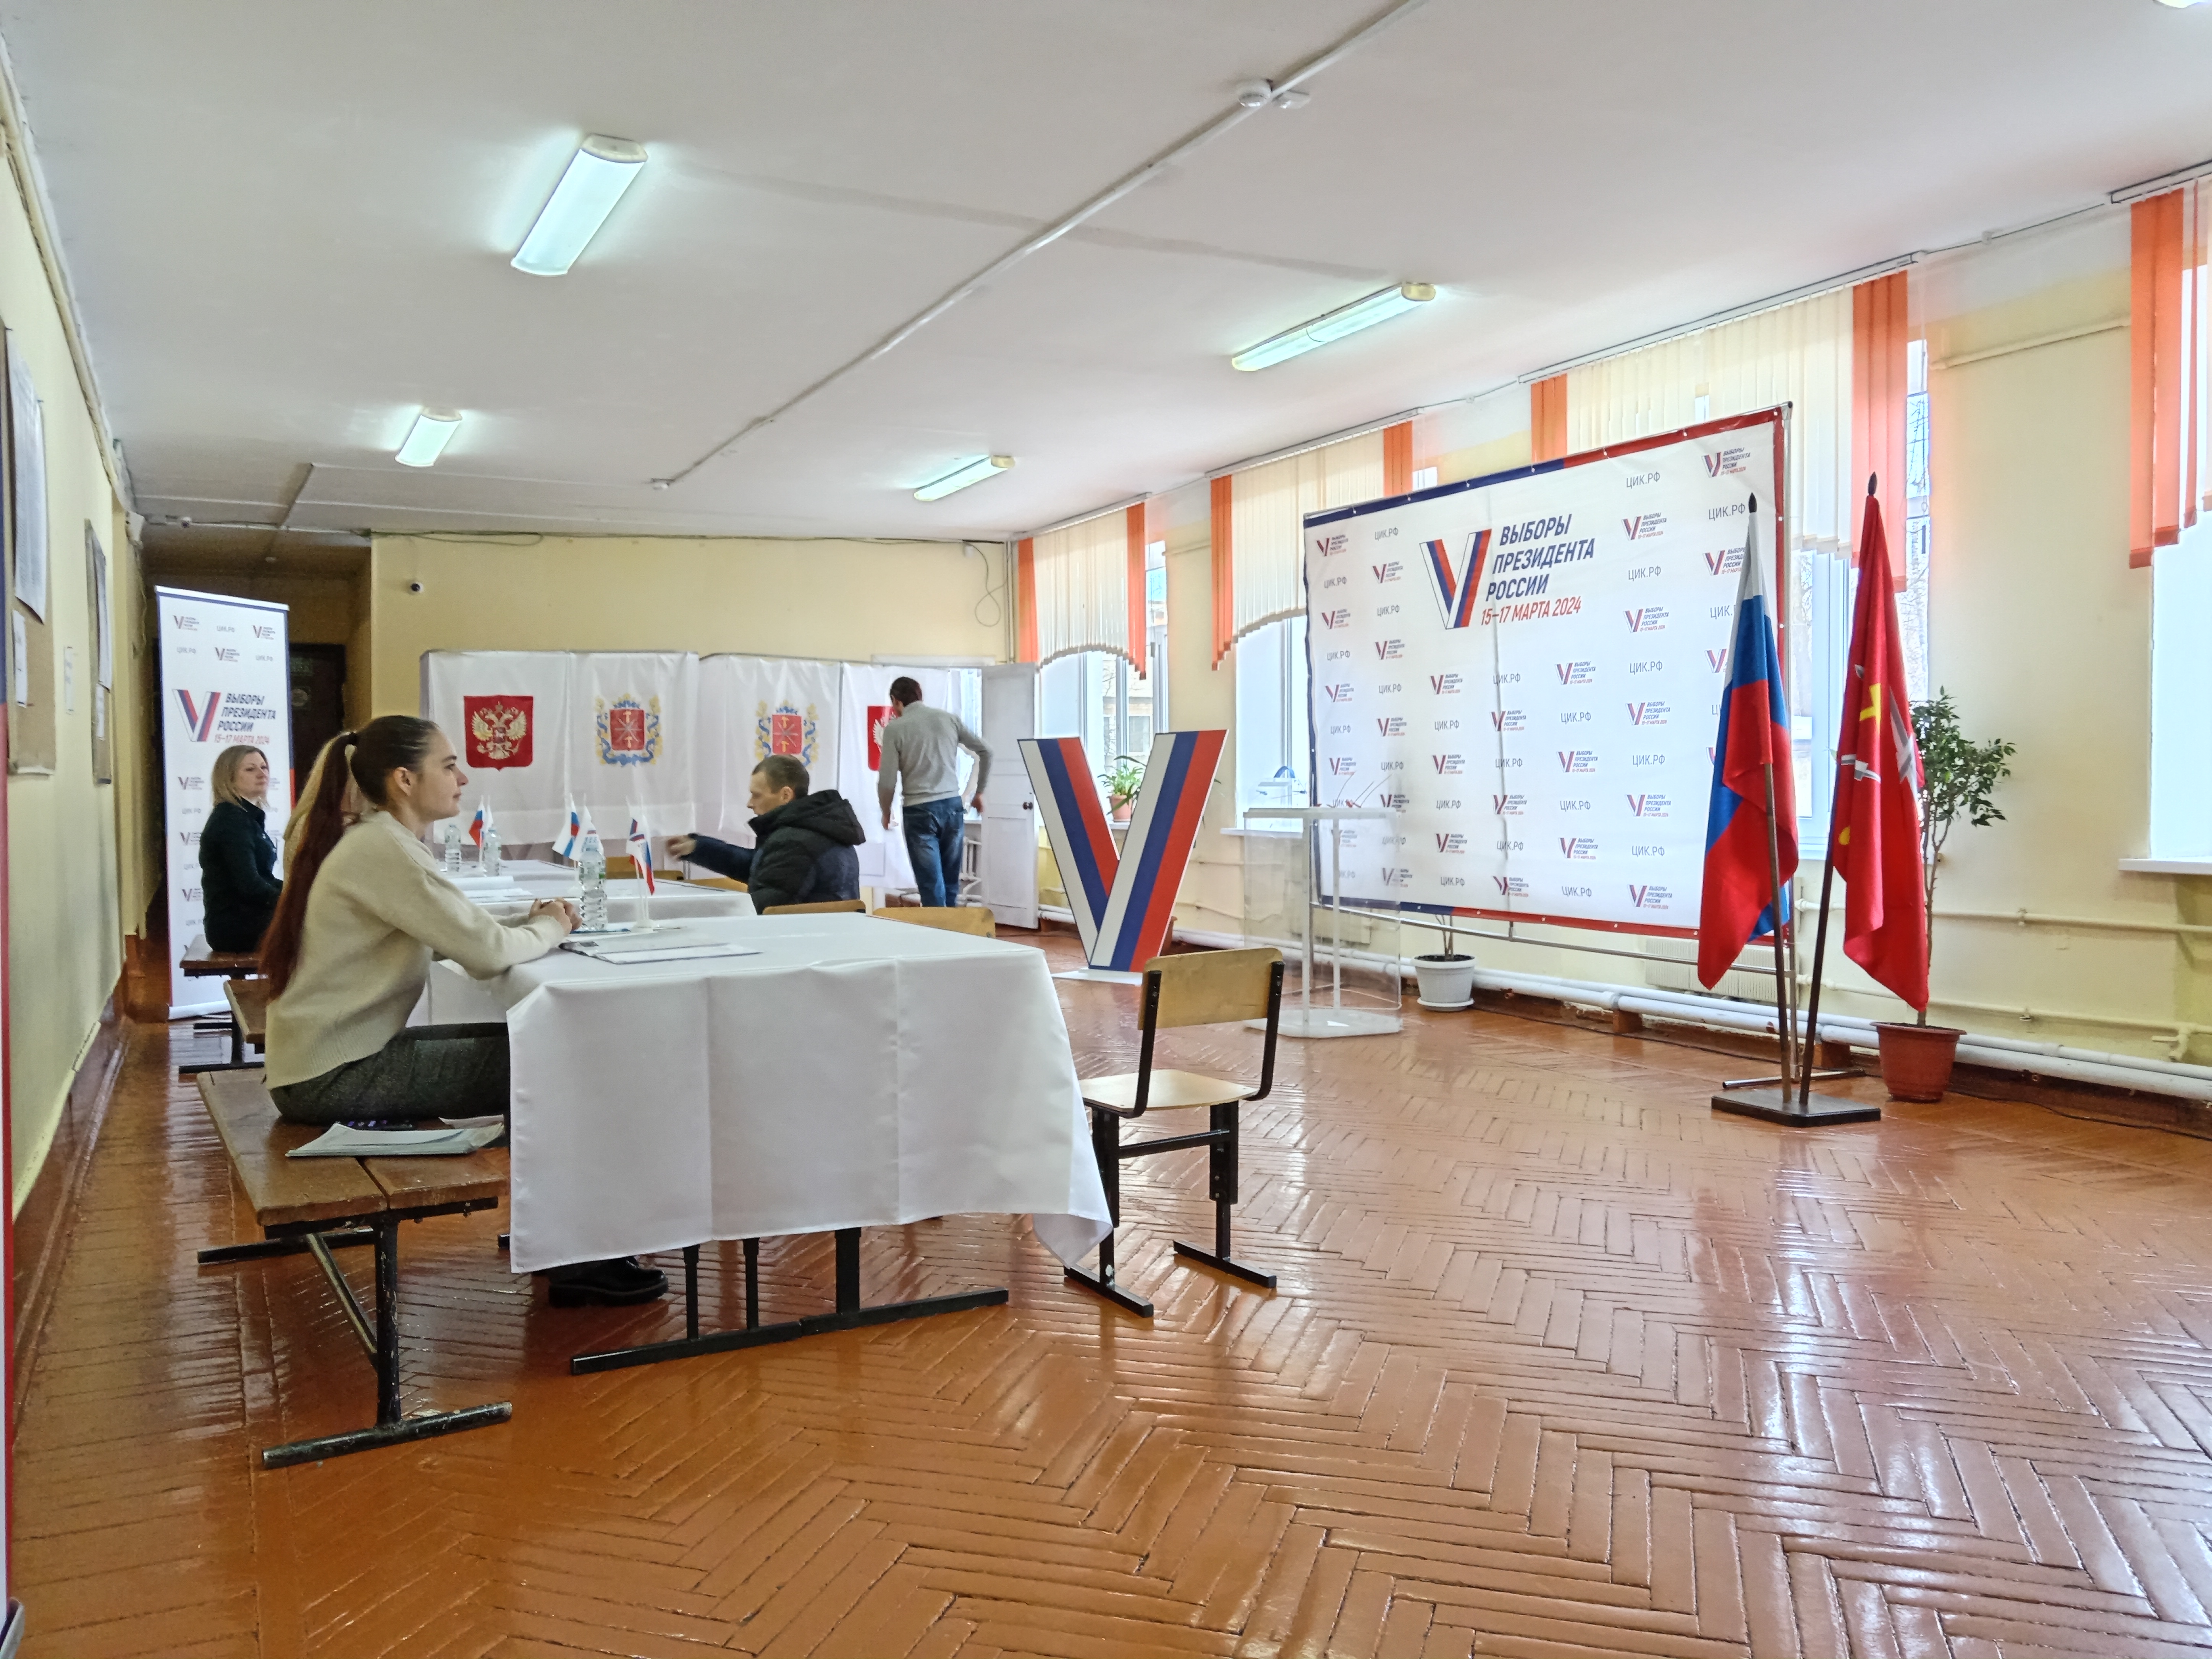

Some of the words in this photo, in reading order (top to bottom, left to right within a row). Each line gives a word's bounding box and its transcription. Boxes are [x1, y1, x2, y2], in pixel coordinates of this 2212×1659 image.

[1627, 472, 1660, 488] ЦИК.РФ
[1709, 503, 1745, 521] ЦИК.РФ
[1641, 518, 1667, 526] ПРЕЗИДЕНТА
[1374, 527, 1399, 541] ЦИК.РФ
[1500, 514, 1572, 546] ВЫБОРЫ
[1492, 538, 1595, 574] ПРЕЗИДЕНТА
[1628, 566, 1661, 581] ЦИК.РФ
[1324, 576, 1347, 589] ЦИК.РФ
[1486, 574, 1549, 602] РОССИИ
[1377, 605, 1399, 616] ЦИК.РФ
[1512, 601, 1550, 621] МАРТА
[1552, 596, 1581, 616] 2024
[1710, 605, 1736, 619] ЦИК.
[1327, 650, 1350, 661] ЦИК.РФ
[1630, 660, 1662, 675] ЦИК.РФ
[1493, 673, 1521, 686] ЦИК.РФ
[1379, 683, 1402, 695] ЦИК.РФ
[226, 693, 265, 705] ВЫБОРЫ
[222, 707, 276, 720] ПРЕЗИДЕНТА
[1561, 711, 1591, 724] ЦИК.РФ
[218, 721, 254, 731] РОССИИ
[1331, 725, 1351, 735] ЦИК.РФ
[1434, 720, 1459, 731] ЦИК.РФ
[233, 735, 254, 744] МАРТА
[255, 736, 270, 744] 2024
[1381, 761, 1404, 771] ЦИК.РФ
[1496, 758, 1523, 769] ЦИК.РФ
[1633, 754, 1665, 767] ЦИК.РФ
[1436, 800, 1461, 810] ЦИК.РФ
[1560, 800, 1591, 812] ЦИК.РФ
[1497, 841, 1523, 851] ЦИК.РФ
[1632, 846, 1665, 857] ЦИК.РФ
[1441, 877, 1465, 886] ЦИК.РФ
[1562, 886, 1592, 897] ЦИК.РФ
